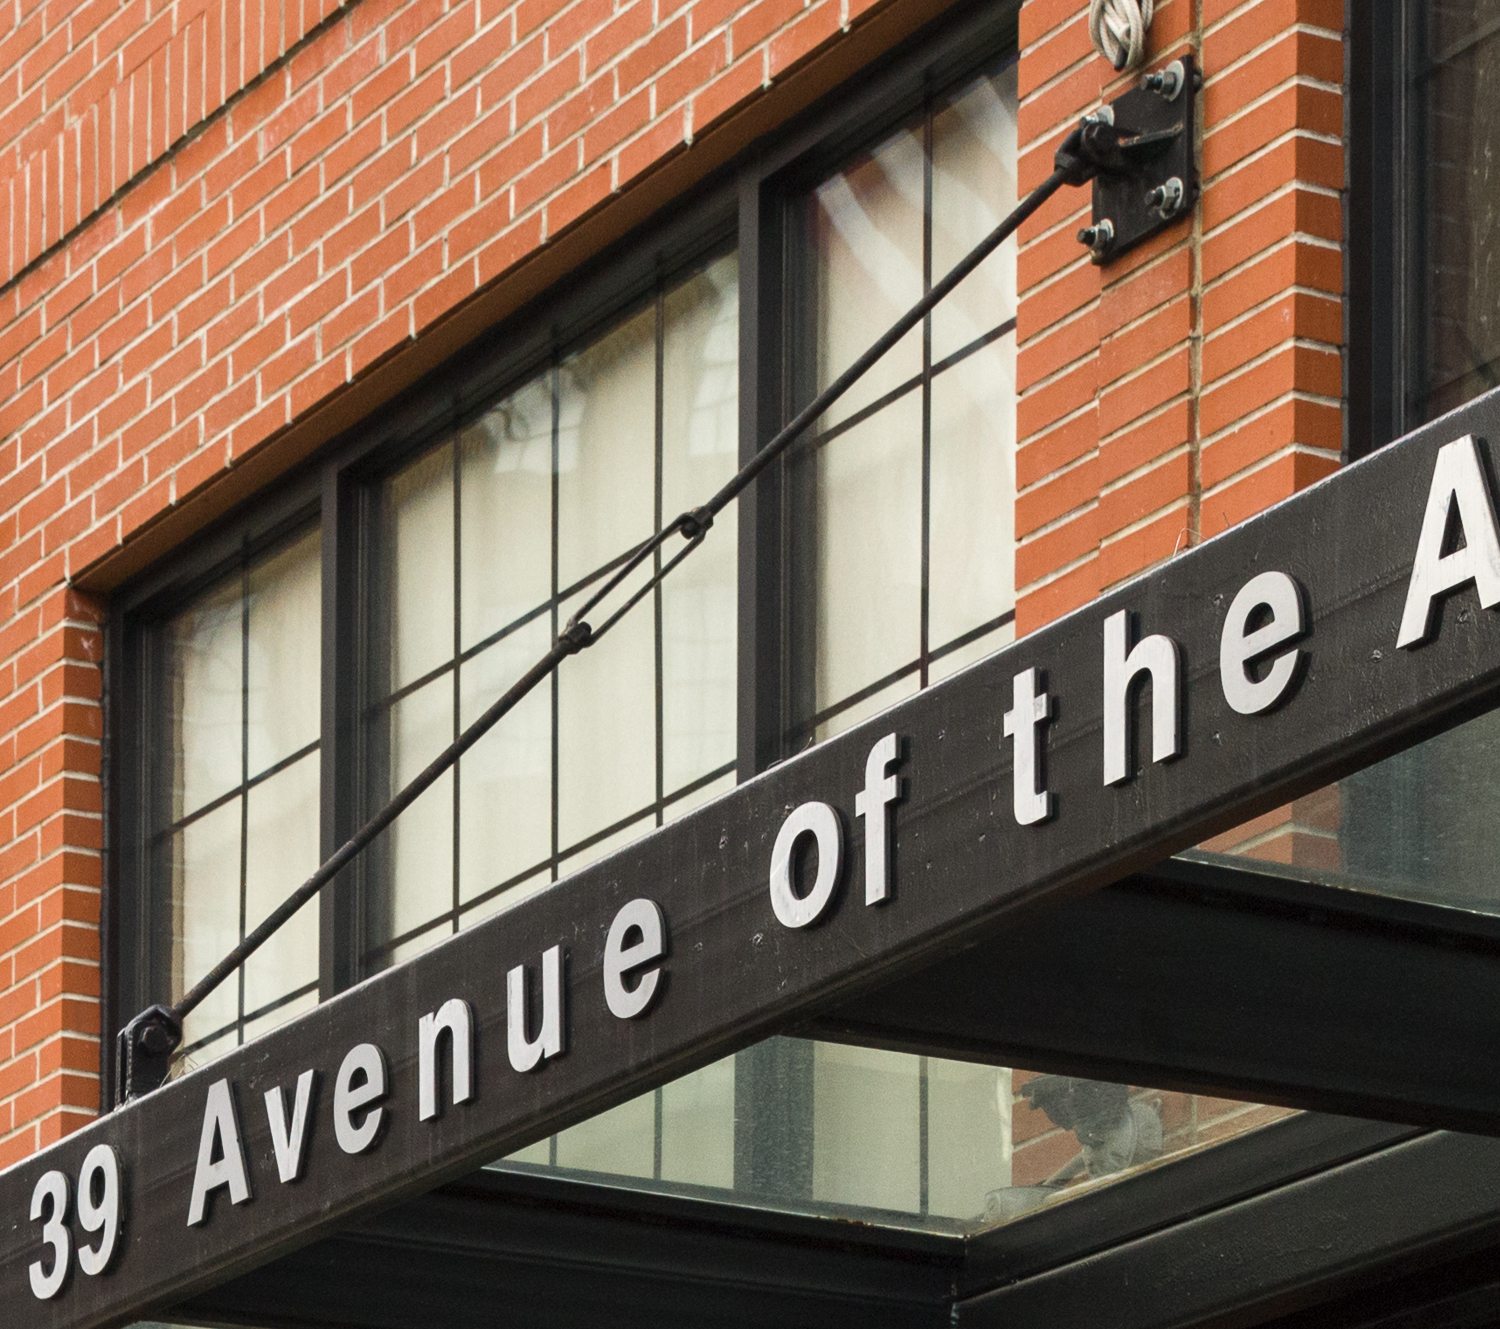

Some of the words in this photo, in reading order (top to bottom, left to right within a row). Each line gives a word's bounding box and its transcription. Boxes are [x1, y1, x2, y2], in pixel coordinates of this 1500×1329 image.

[28, 1143, 124, 1301] 39
[187, 896, 668, 1227] Avenue
[769, 732, 904, 929] of
[1003, 570, 1306, 827] the
